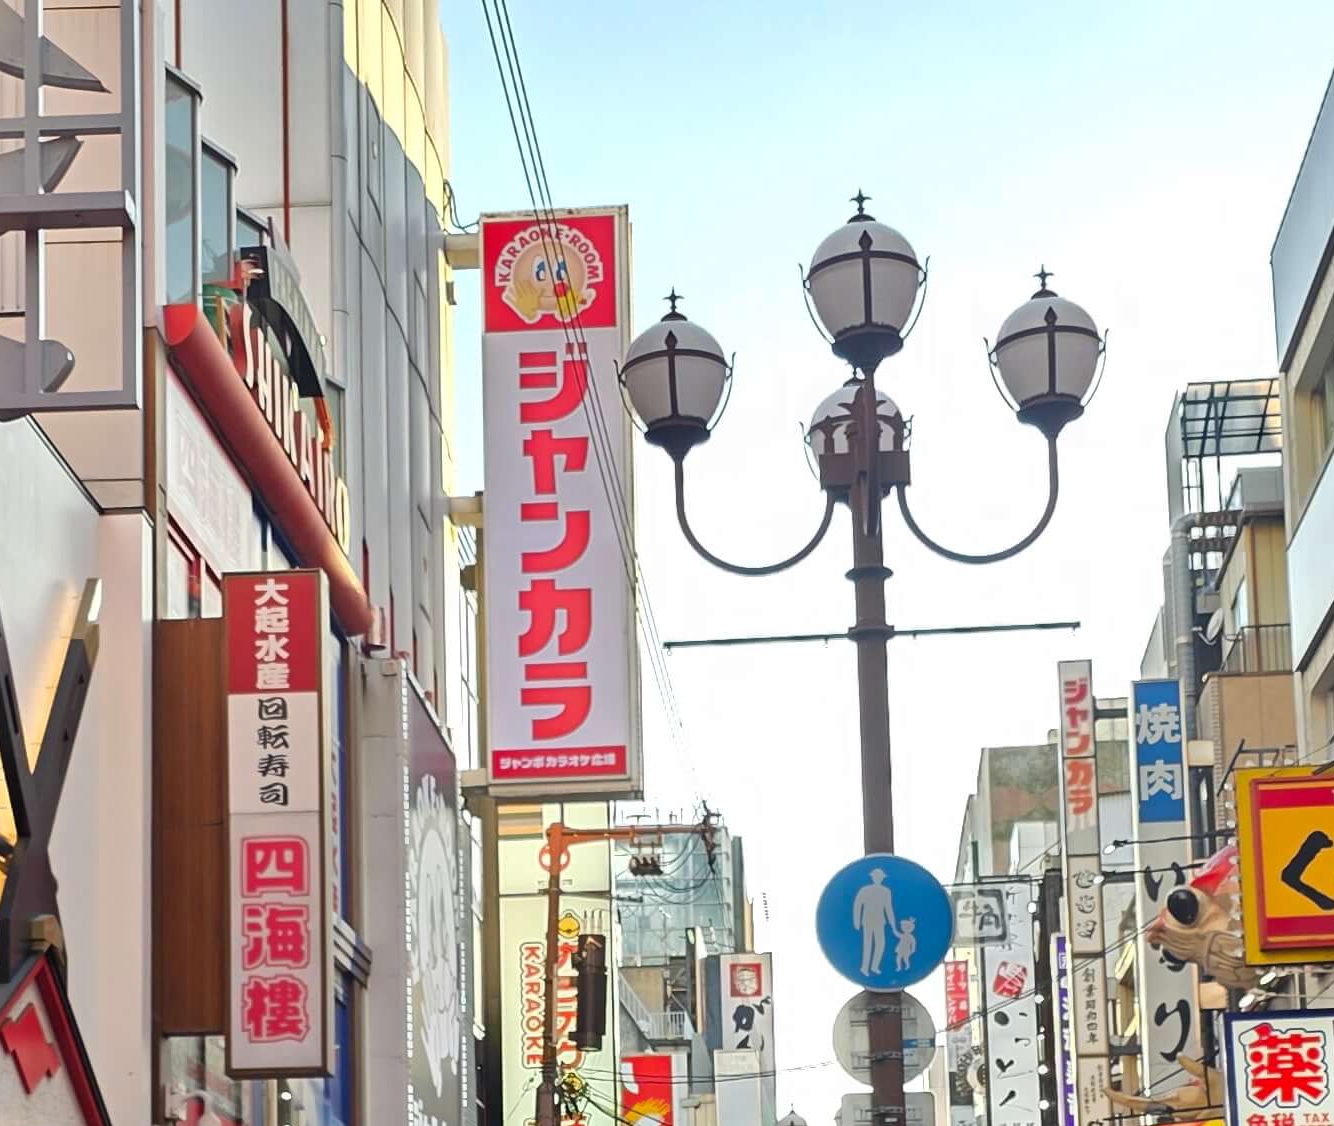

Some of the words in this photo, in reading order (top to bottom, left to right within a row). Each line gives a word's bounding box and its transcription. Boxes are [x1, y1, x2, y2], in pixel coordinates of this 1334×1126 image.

[518, 342, 592, 741] ジャンカラ
[254, 578, 290, 691] 大起水産
[257, 697, 289, 807] 回転寿司
[1063, 680, 1093, 816] ジャンカラ
[1136, 703, 1182, 801] 焼肉
[241, 836, 311, 1043] 四海樓
[1241, 1024, 1328, 1106] 薬
[1302, 1112, 1330, 1124] TAX
